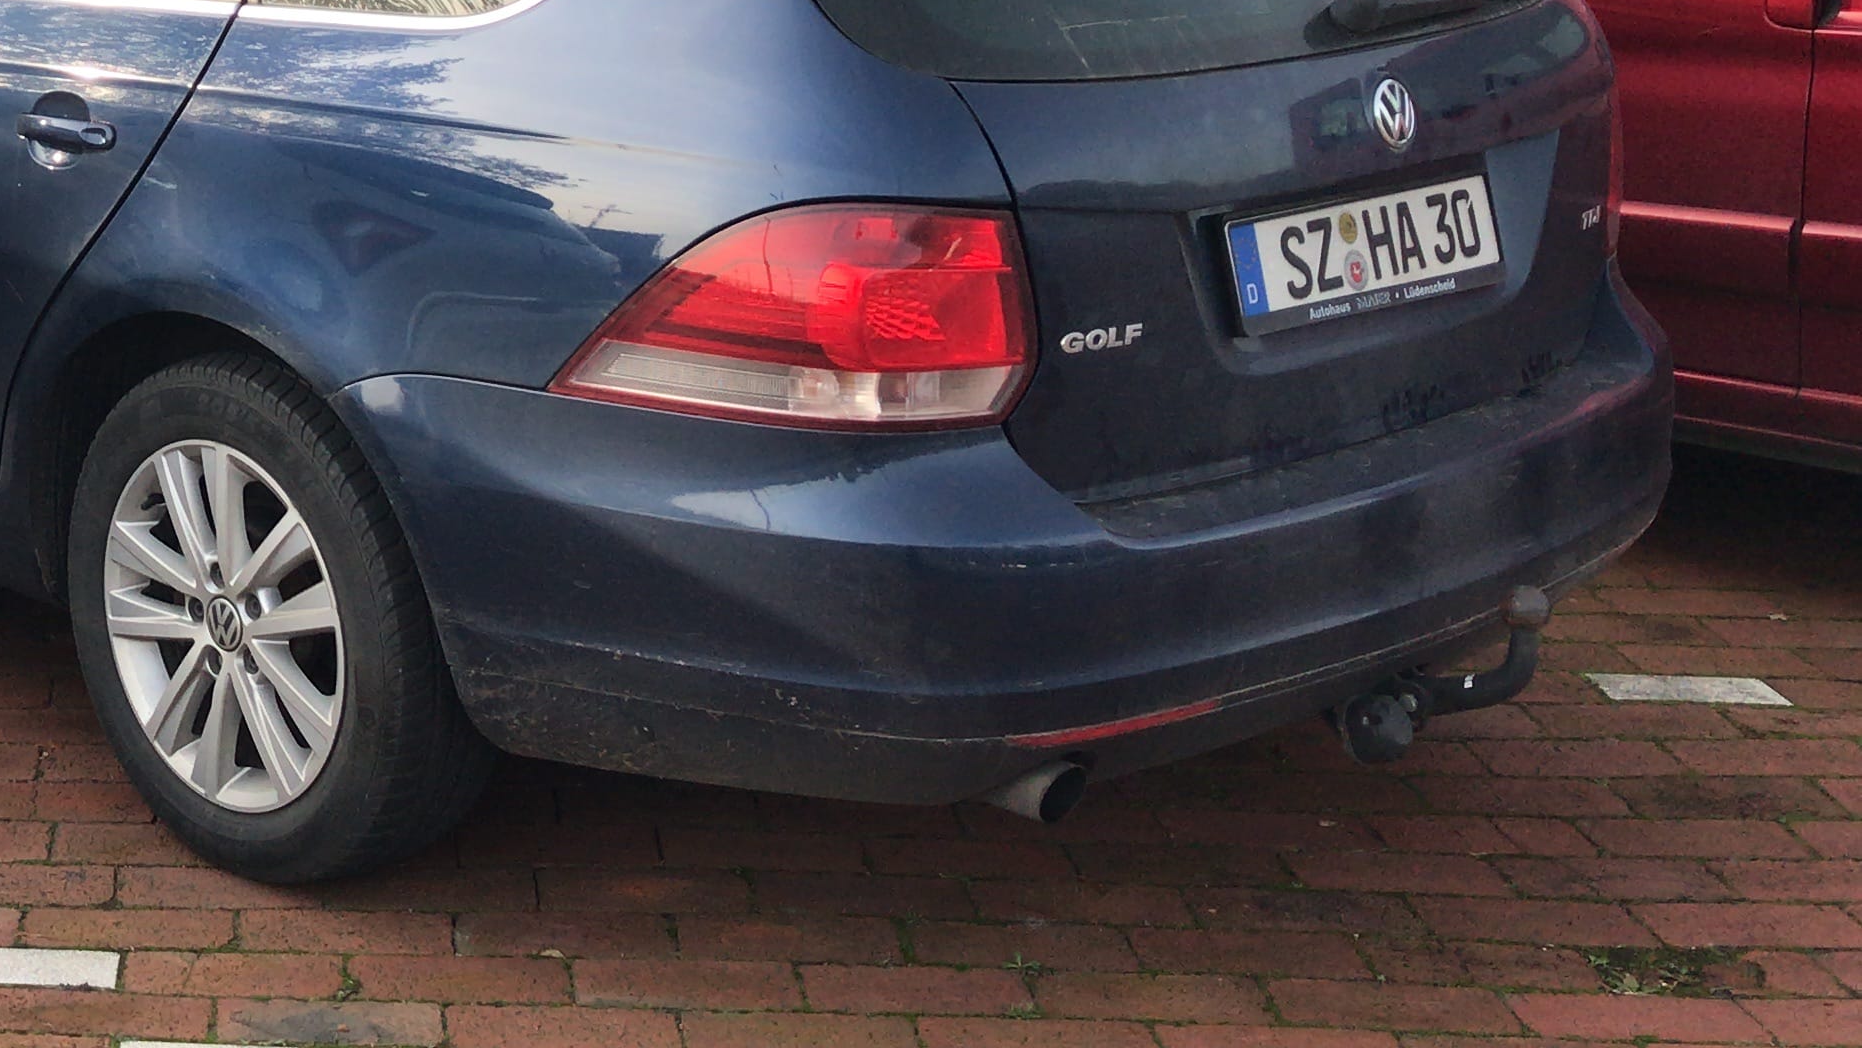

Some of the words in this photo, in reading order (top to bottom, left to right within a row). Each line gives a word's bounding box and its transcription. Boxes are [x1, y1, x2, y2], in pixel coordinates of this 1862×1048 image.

[1247, 283, 1259, 305] D
[1279, 217, 1343, 300] SZ
[1365, 197, 1428, 280] HA
[1426, 188, 1482, 264] 30
[1309, 302, 1352, 320] Autohaus
[1403, 277, 1456, 299] Lüdenscheid
[1059, 323, 1144, 354] GOLF
